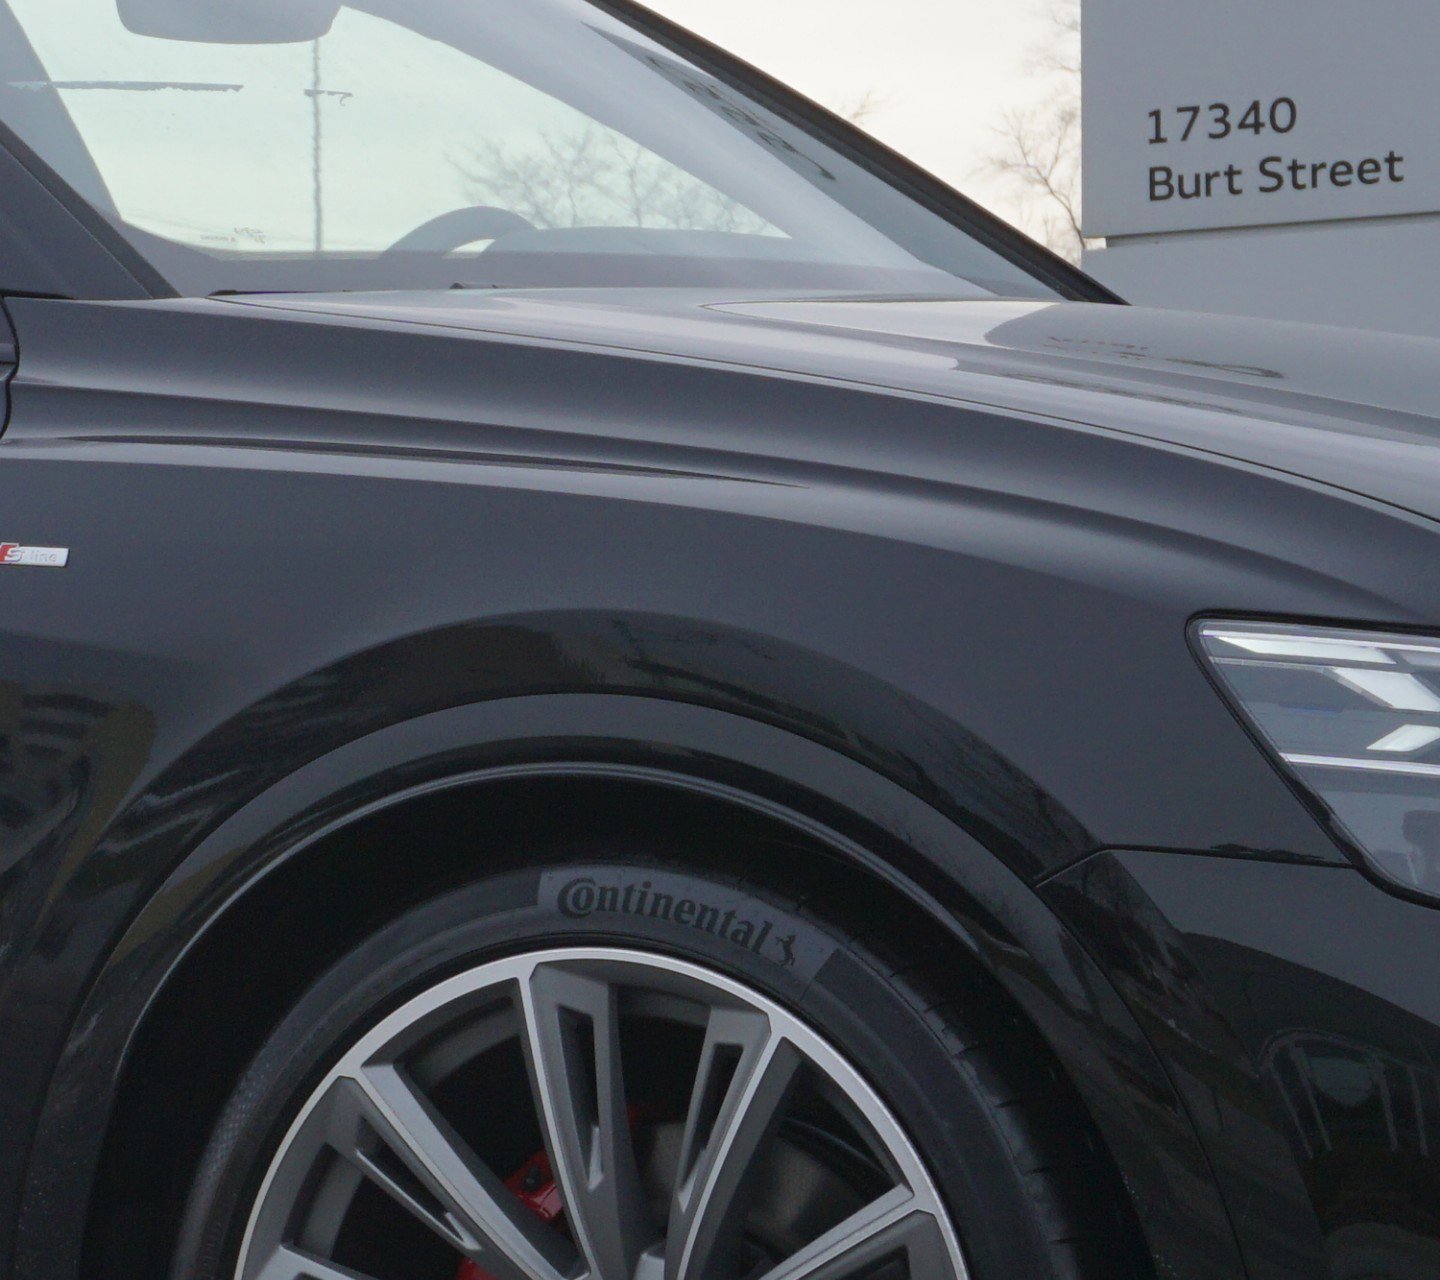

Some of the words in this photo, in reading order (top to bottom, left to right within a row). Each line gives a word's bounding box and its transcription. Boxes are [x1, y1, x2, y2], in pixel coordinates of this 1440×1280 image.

[1147, 96, 1298, 145] 17340
[1148, 164, 1243, 202] Burt
[1258, 150, 1405, 193] Street
[556, 877, 773, 955] Continental
